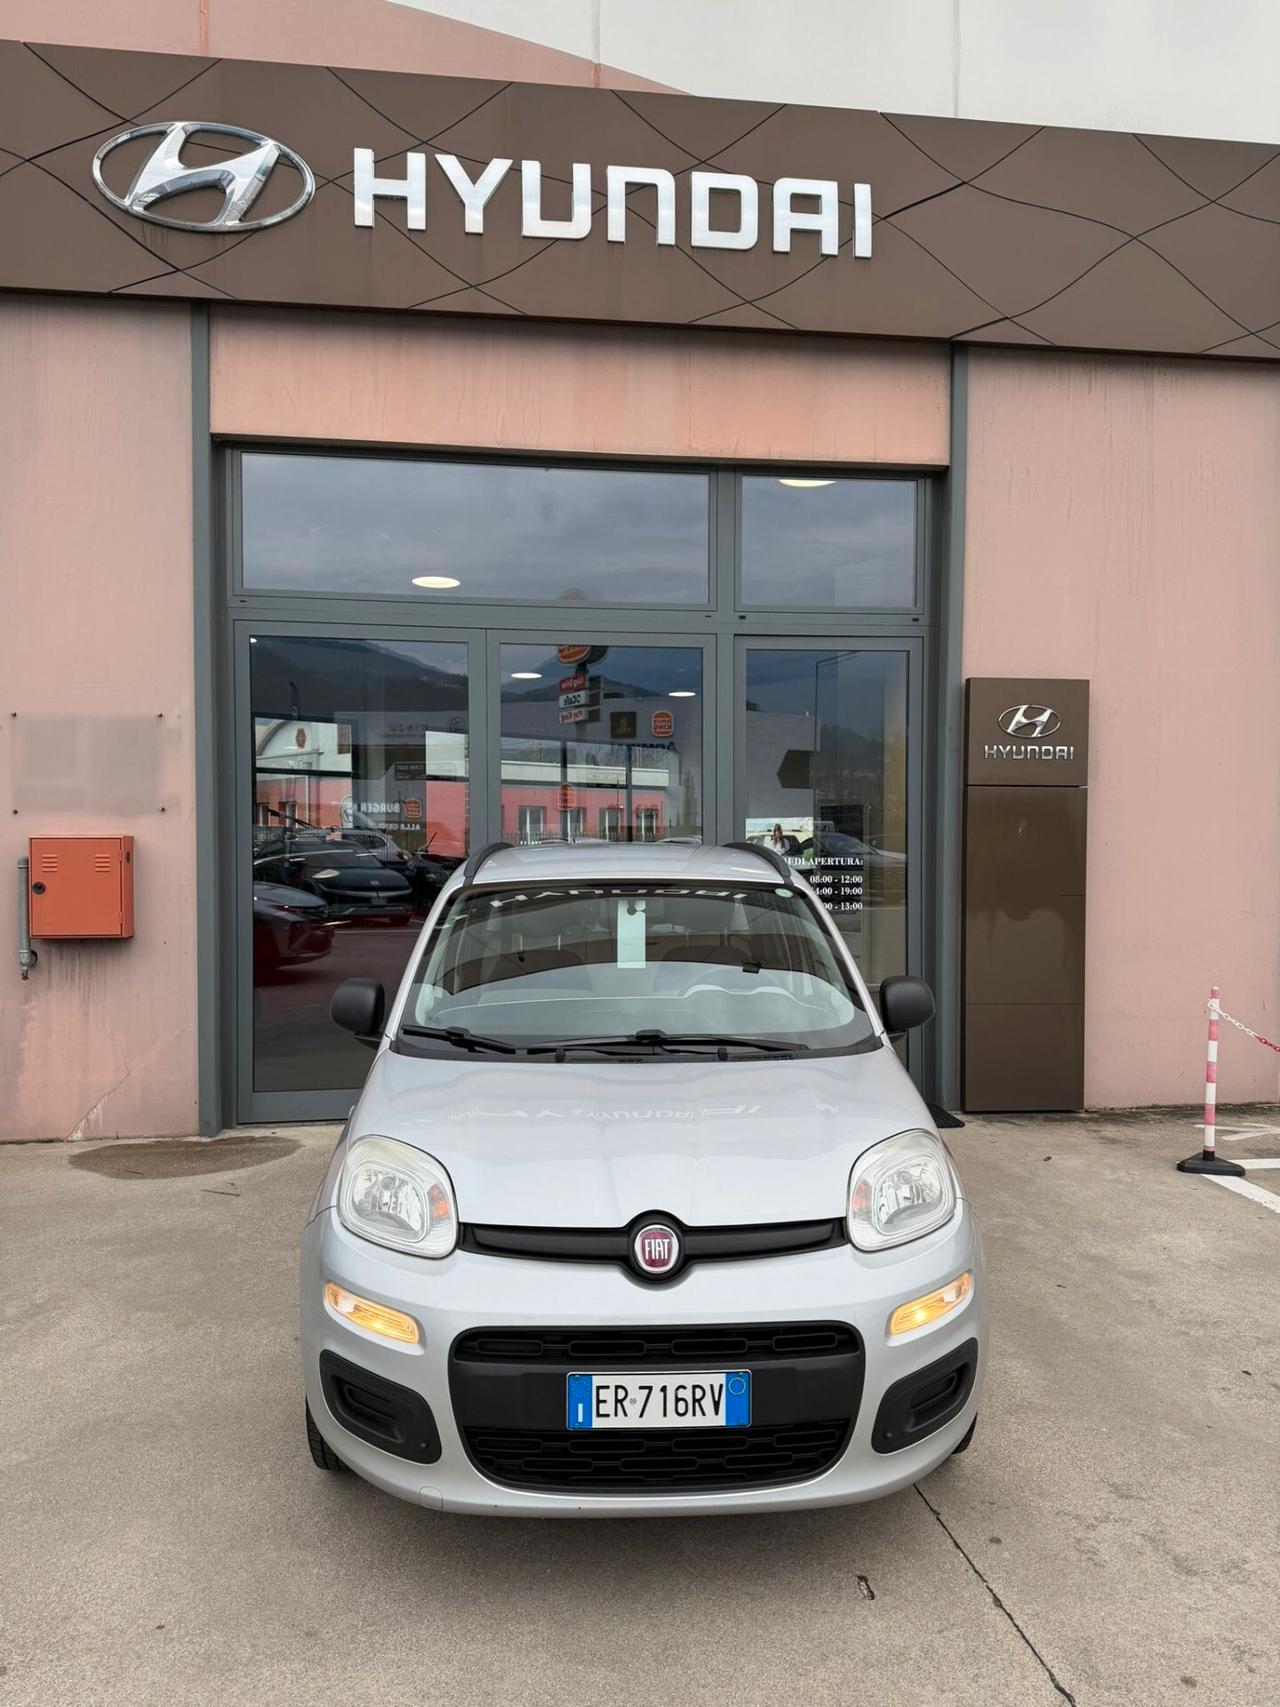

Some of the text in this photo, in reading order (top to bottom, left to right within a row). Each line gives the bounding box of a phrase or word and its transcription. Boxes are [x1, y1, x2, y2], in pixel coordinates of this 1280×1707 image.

[352, 147, 873, 259] HYUNDAI
[984, 744, 1075, 760] HYUNDAI
[808, 857, 864, 866] APERTURA:
[809, 875, 833, 884] 08:00
[841, 875, 863, 884] 12:00
[841, 887, 863, 895] 19:00
[841, 902, 863, 910] 13:00
[644, 1239, 670, 1260] FIAT
